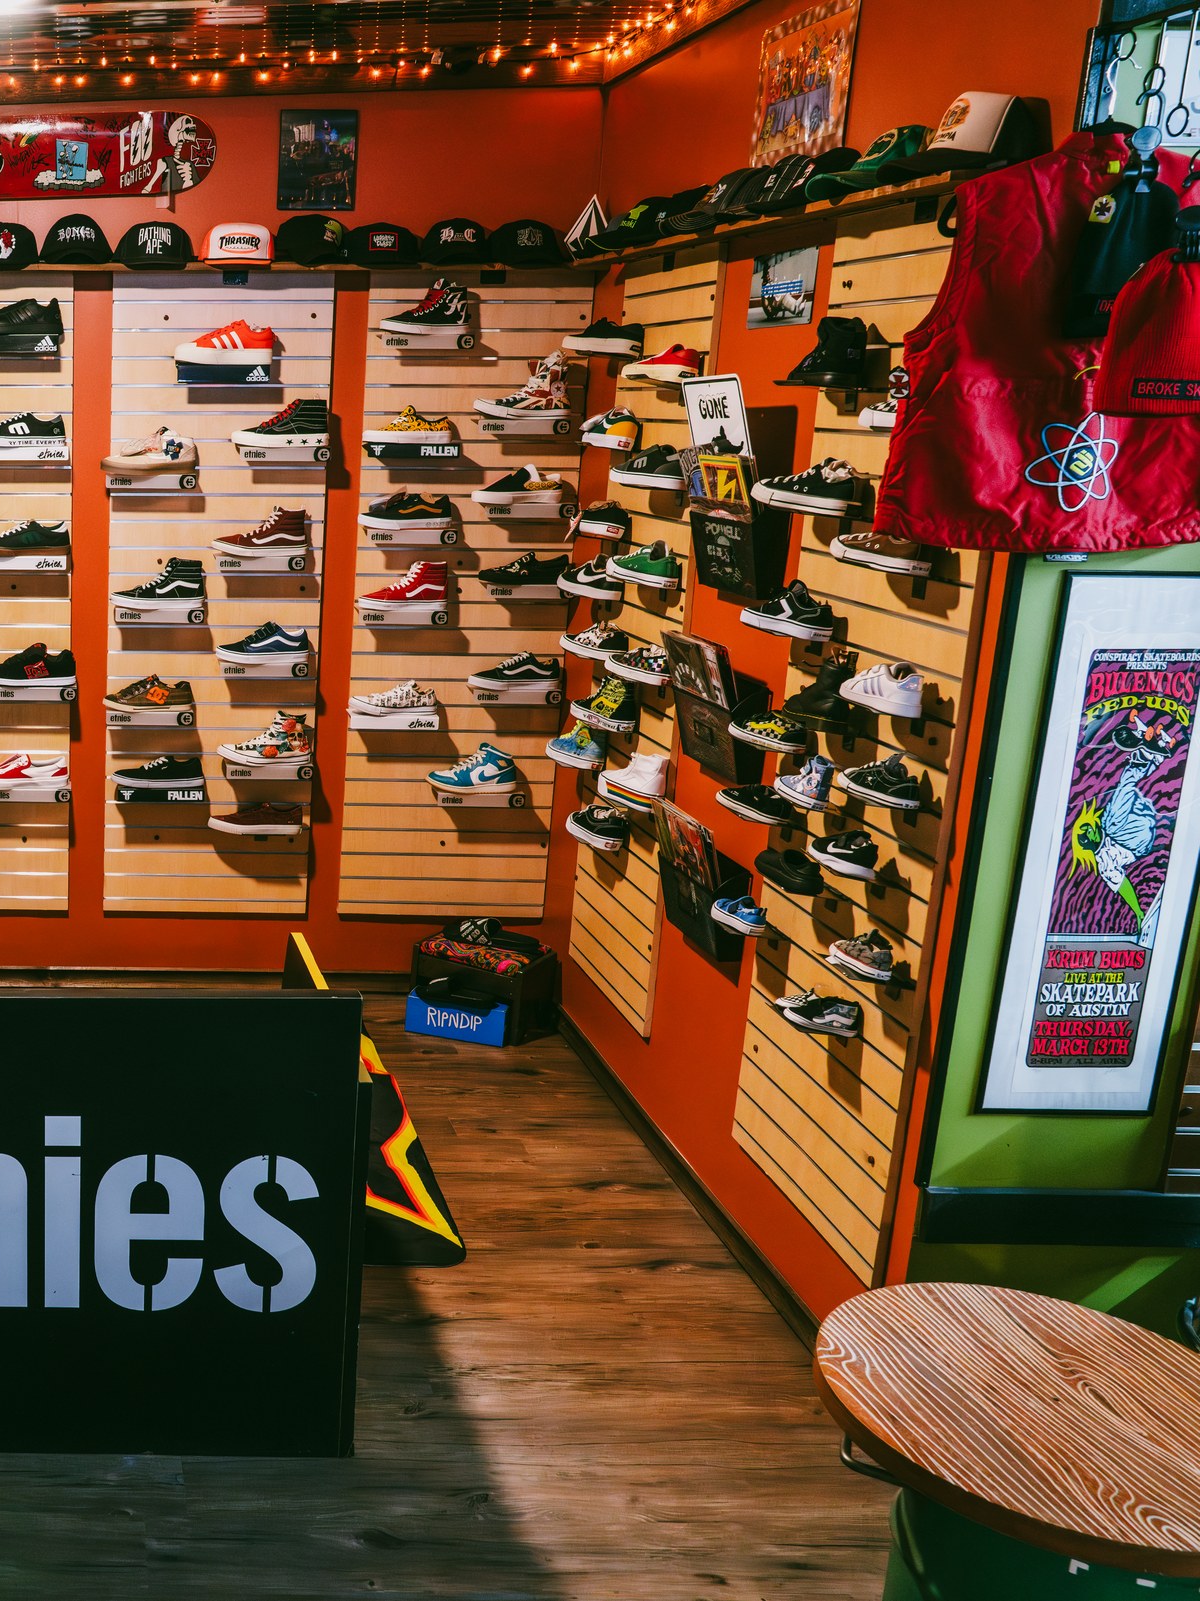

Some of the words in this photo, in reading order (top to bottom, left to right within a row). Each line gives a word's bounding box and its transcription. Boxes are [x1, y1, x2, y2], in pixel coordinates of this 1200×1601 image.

[120, 111, 154, 173] FOO
[120, 161, 152, 189] FIGHTERS
[57, 226, 96, 243] BONES
[138, 226, 172, 247] BATHING
[146, 239, 163, 255] APE
[219, 236, 261, 250] THRASHER
[385, 336, 409, 347] etnies
[1137, 382, 1181, 396] BROKE
[698, 395, 730, 419] GONE
[482, 422, 505, 432] etnies
[244, 450, 266, 459] etnies
[420, 445, 458, 457] FALLEN
[110, 477, 132, 486] etnies
[488, 506, 511, 515] etnies
[370, 532, 393, 541] etnies
[219, 559, 242, 568] etnies
[490, 587, 513, 596] etnies
[119, 611, 142, 620] etnies
[362, 613, 385, 622] etnies
[1094, 652, 1143, 662] CONSPIRACY
[1143, 652, 1200, 662] SKATEBOARDS
[223, 665, 246, 675] etnies
[1126, 661, 1168, 670] PRESENTS
[1087, 671, 1198, 707] BULEMICS
[477, 692, 499, 701] etnies
[1083, 695, 1191, 727] FED-UPS
[109, 713, 132, 722] etnies
[230, 768, 252, 777] etnies
[167, 790, 203, 801] FALLEN
[441, 796, 463, 805] etnies
[1045, 950, 1096, 969] KRUM
[1098, 950, 1146, 969] BUMS
[1064, 972, 1088, 984] LIVE
[1088, 972, 1104, 984] AT
[1104, 972, 1125, 984] THE
[1040, 982, 1142, 1004] SKATEPARK
[1046, 1003, 1066, 1017] OF
[1068, 1003, 1132, 1017] AUSTIN
[426, 1007, 483, 1032] RIPNDIP
[1035, 1020, 1133, 1037] THURSDAY,
[1031, 1038, 1091, 1056] MARCH
[1092, 1038, 1131, 1056] 13TH
